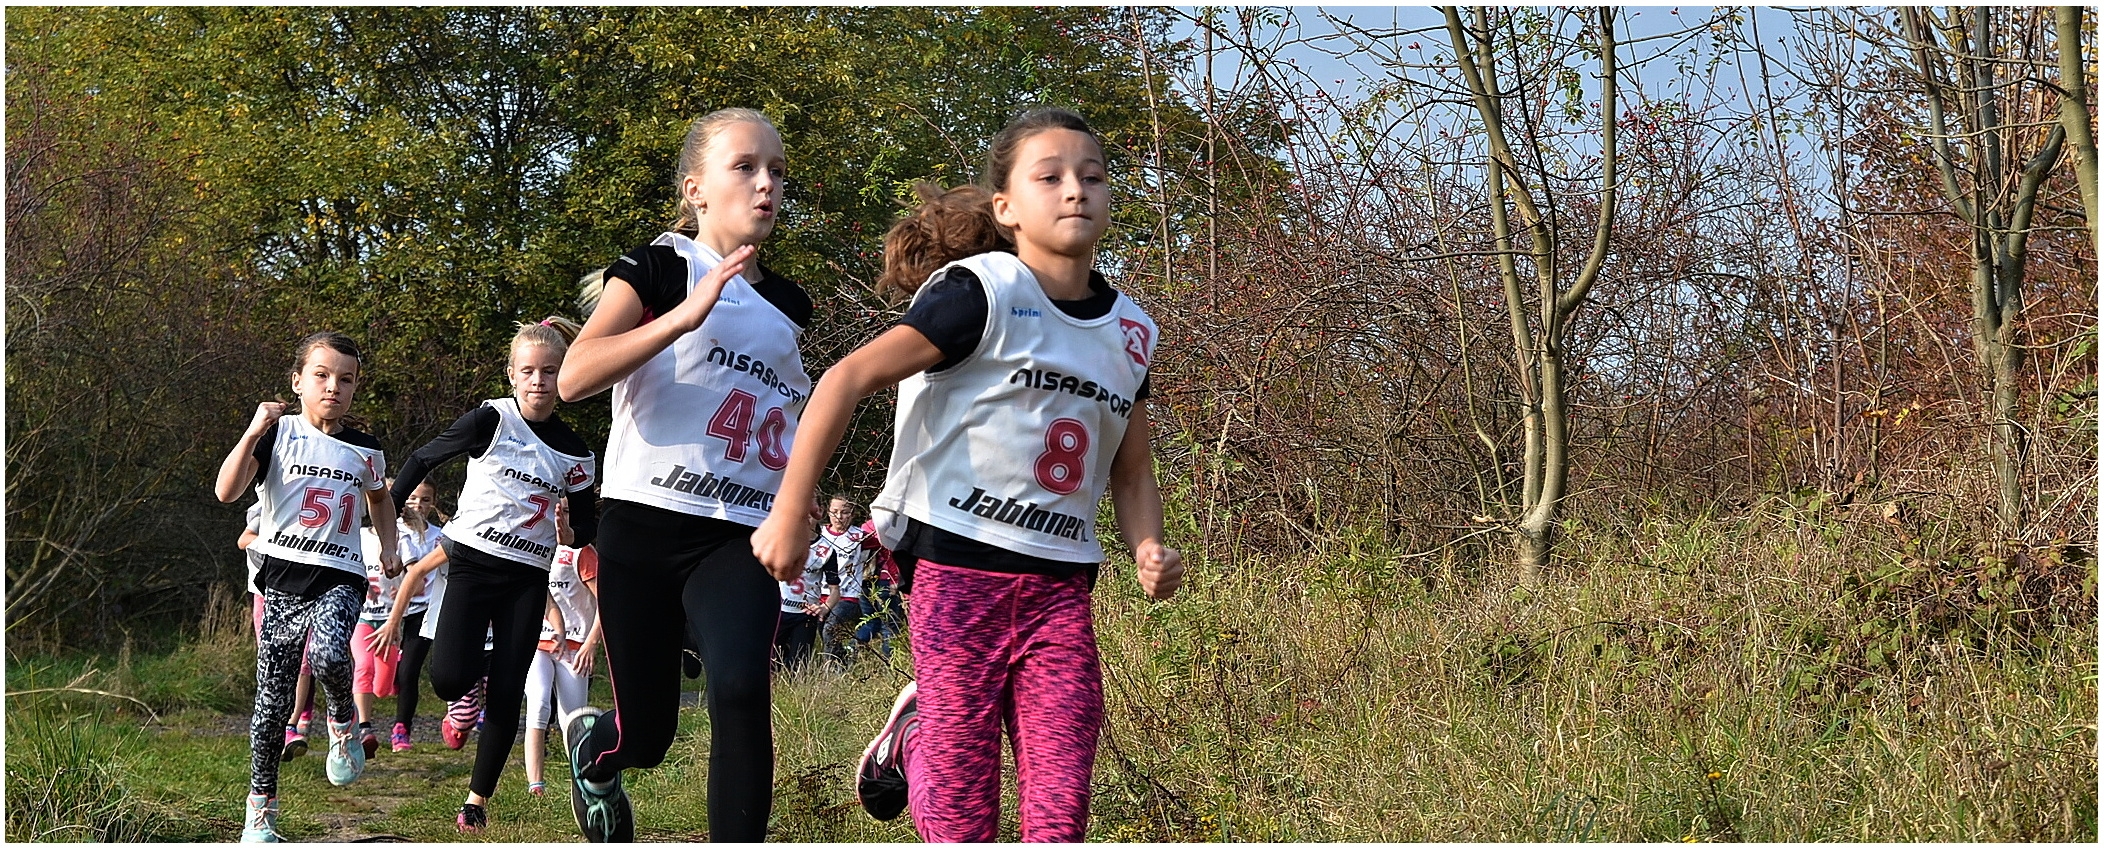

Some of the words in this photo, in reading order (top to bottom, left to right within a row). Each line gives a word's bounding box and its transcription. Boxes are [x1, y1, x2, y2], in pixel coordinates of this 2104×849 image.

[718, 296, 741, 306] print
[1010, 368, 1133, 420] NISASPOR
[706, 388, 790, 472] 40
[1033, 418, 1089, 496] 8
[298, 486, 356, 535] 51
[520, 494, 551, 530] 7
[650, 464, 776, 512] Jablonec
[268, 531, 350, 559] Jablonec
[475, 527, 551, 559] Jablonec
